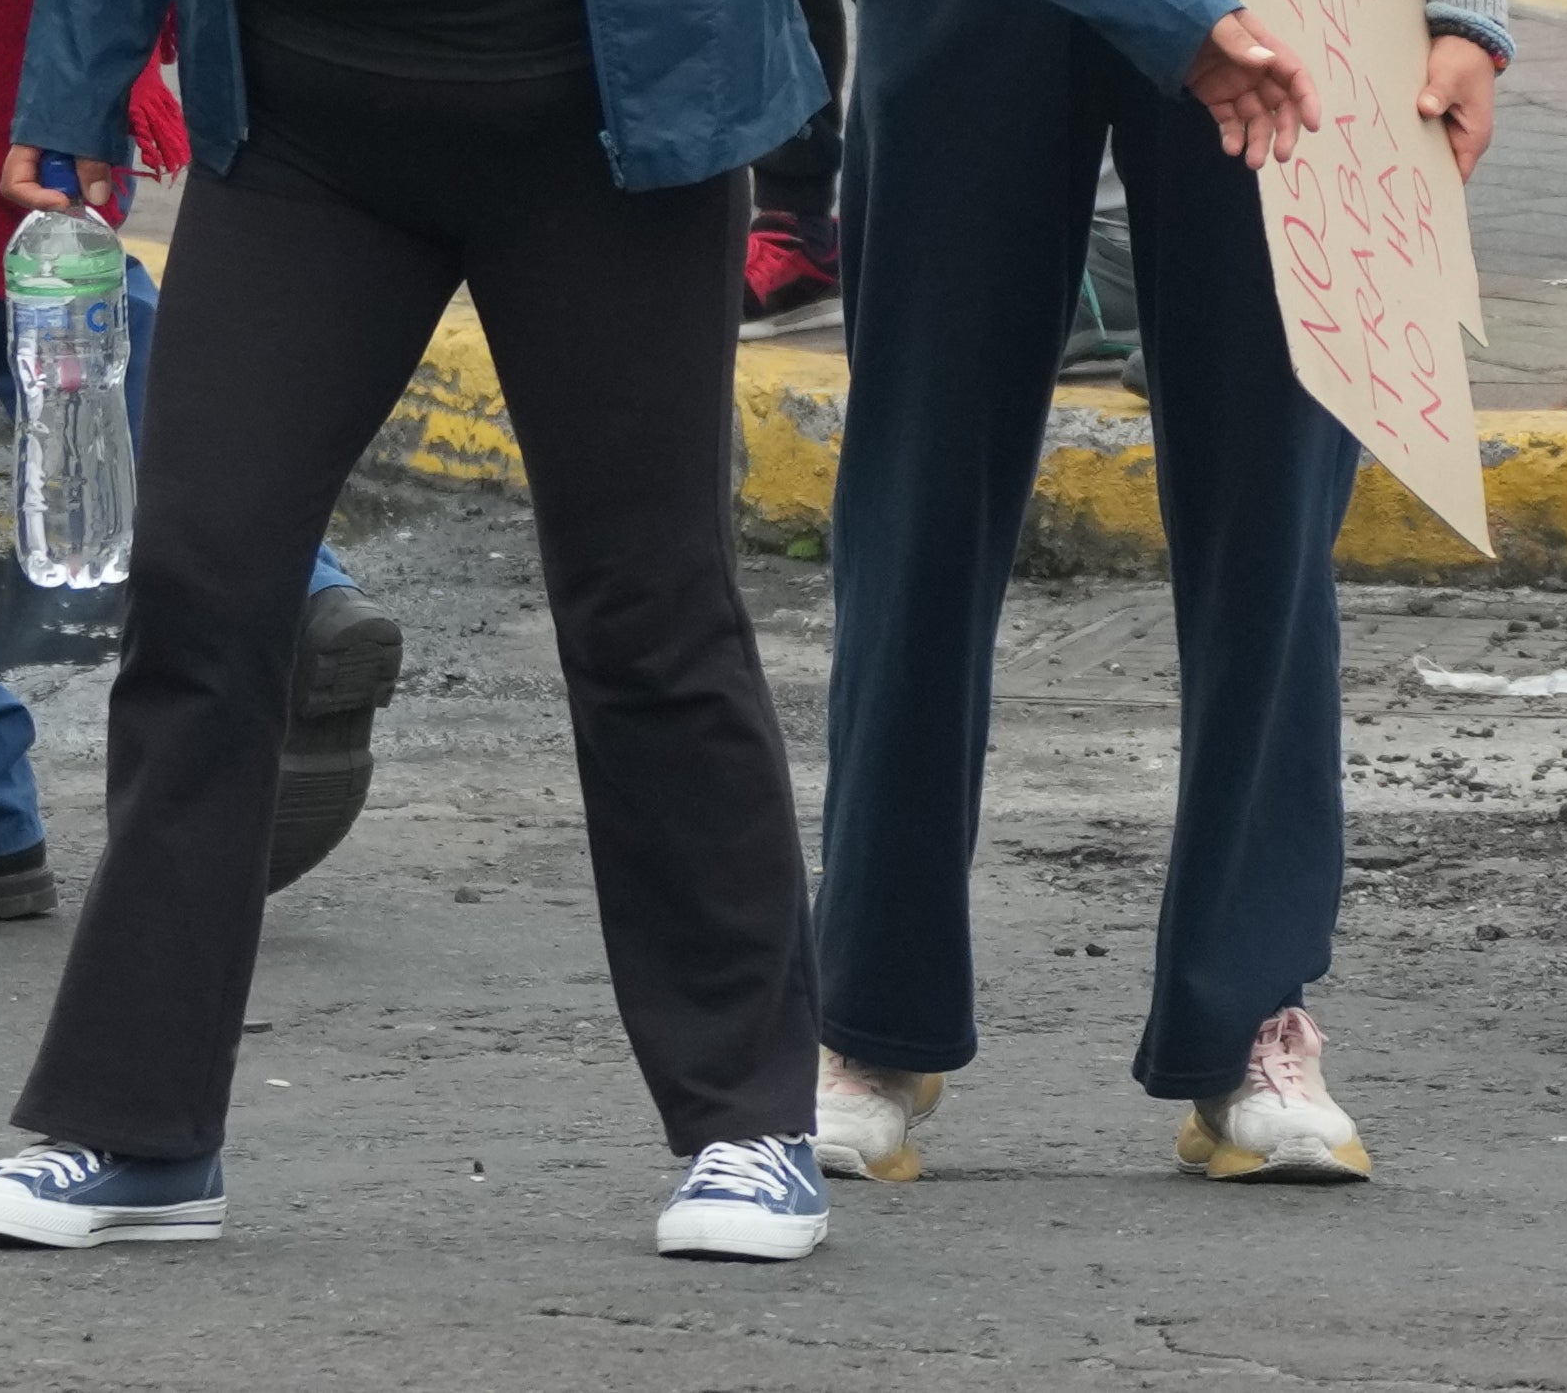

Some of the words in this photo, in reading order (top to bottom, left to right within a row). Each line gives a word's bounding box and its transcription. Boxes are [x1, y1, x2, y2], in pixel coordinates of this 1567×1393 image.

[1364, 74, 1414, 268] HAY
[1279, 157, 1352, 384] NOS
[1404, 320, 1450, 443] NO
